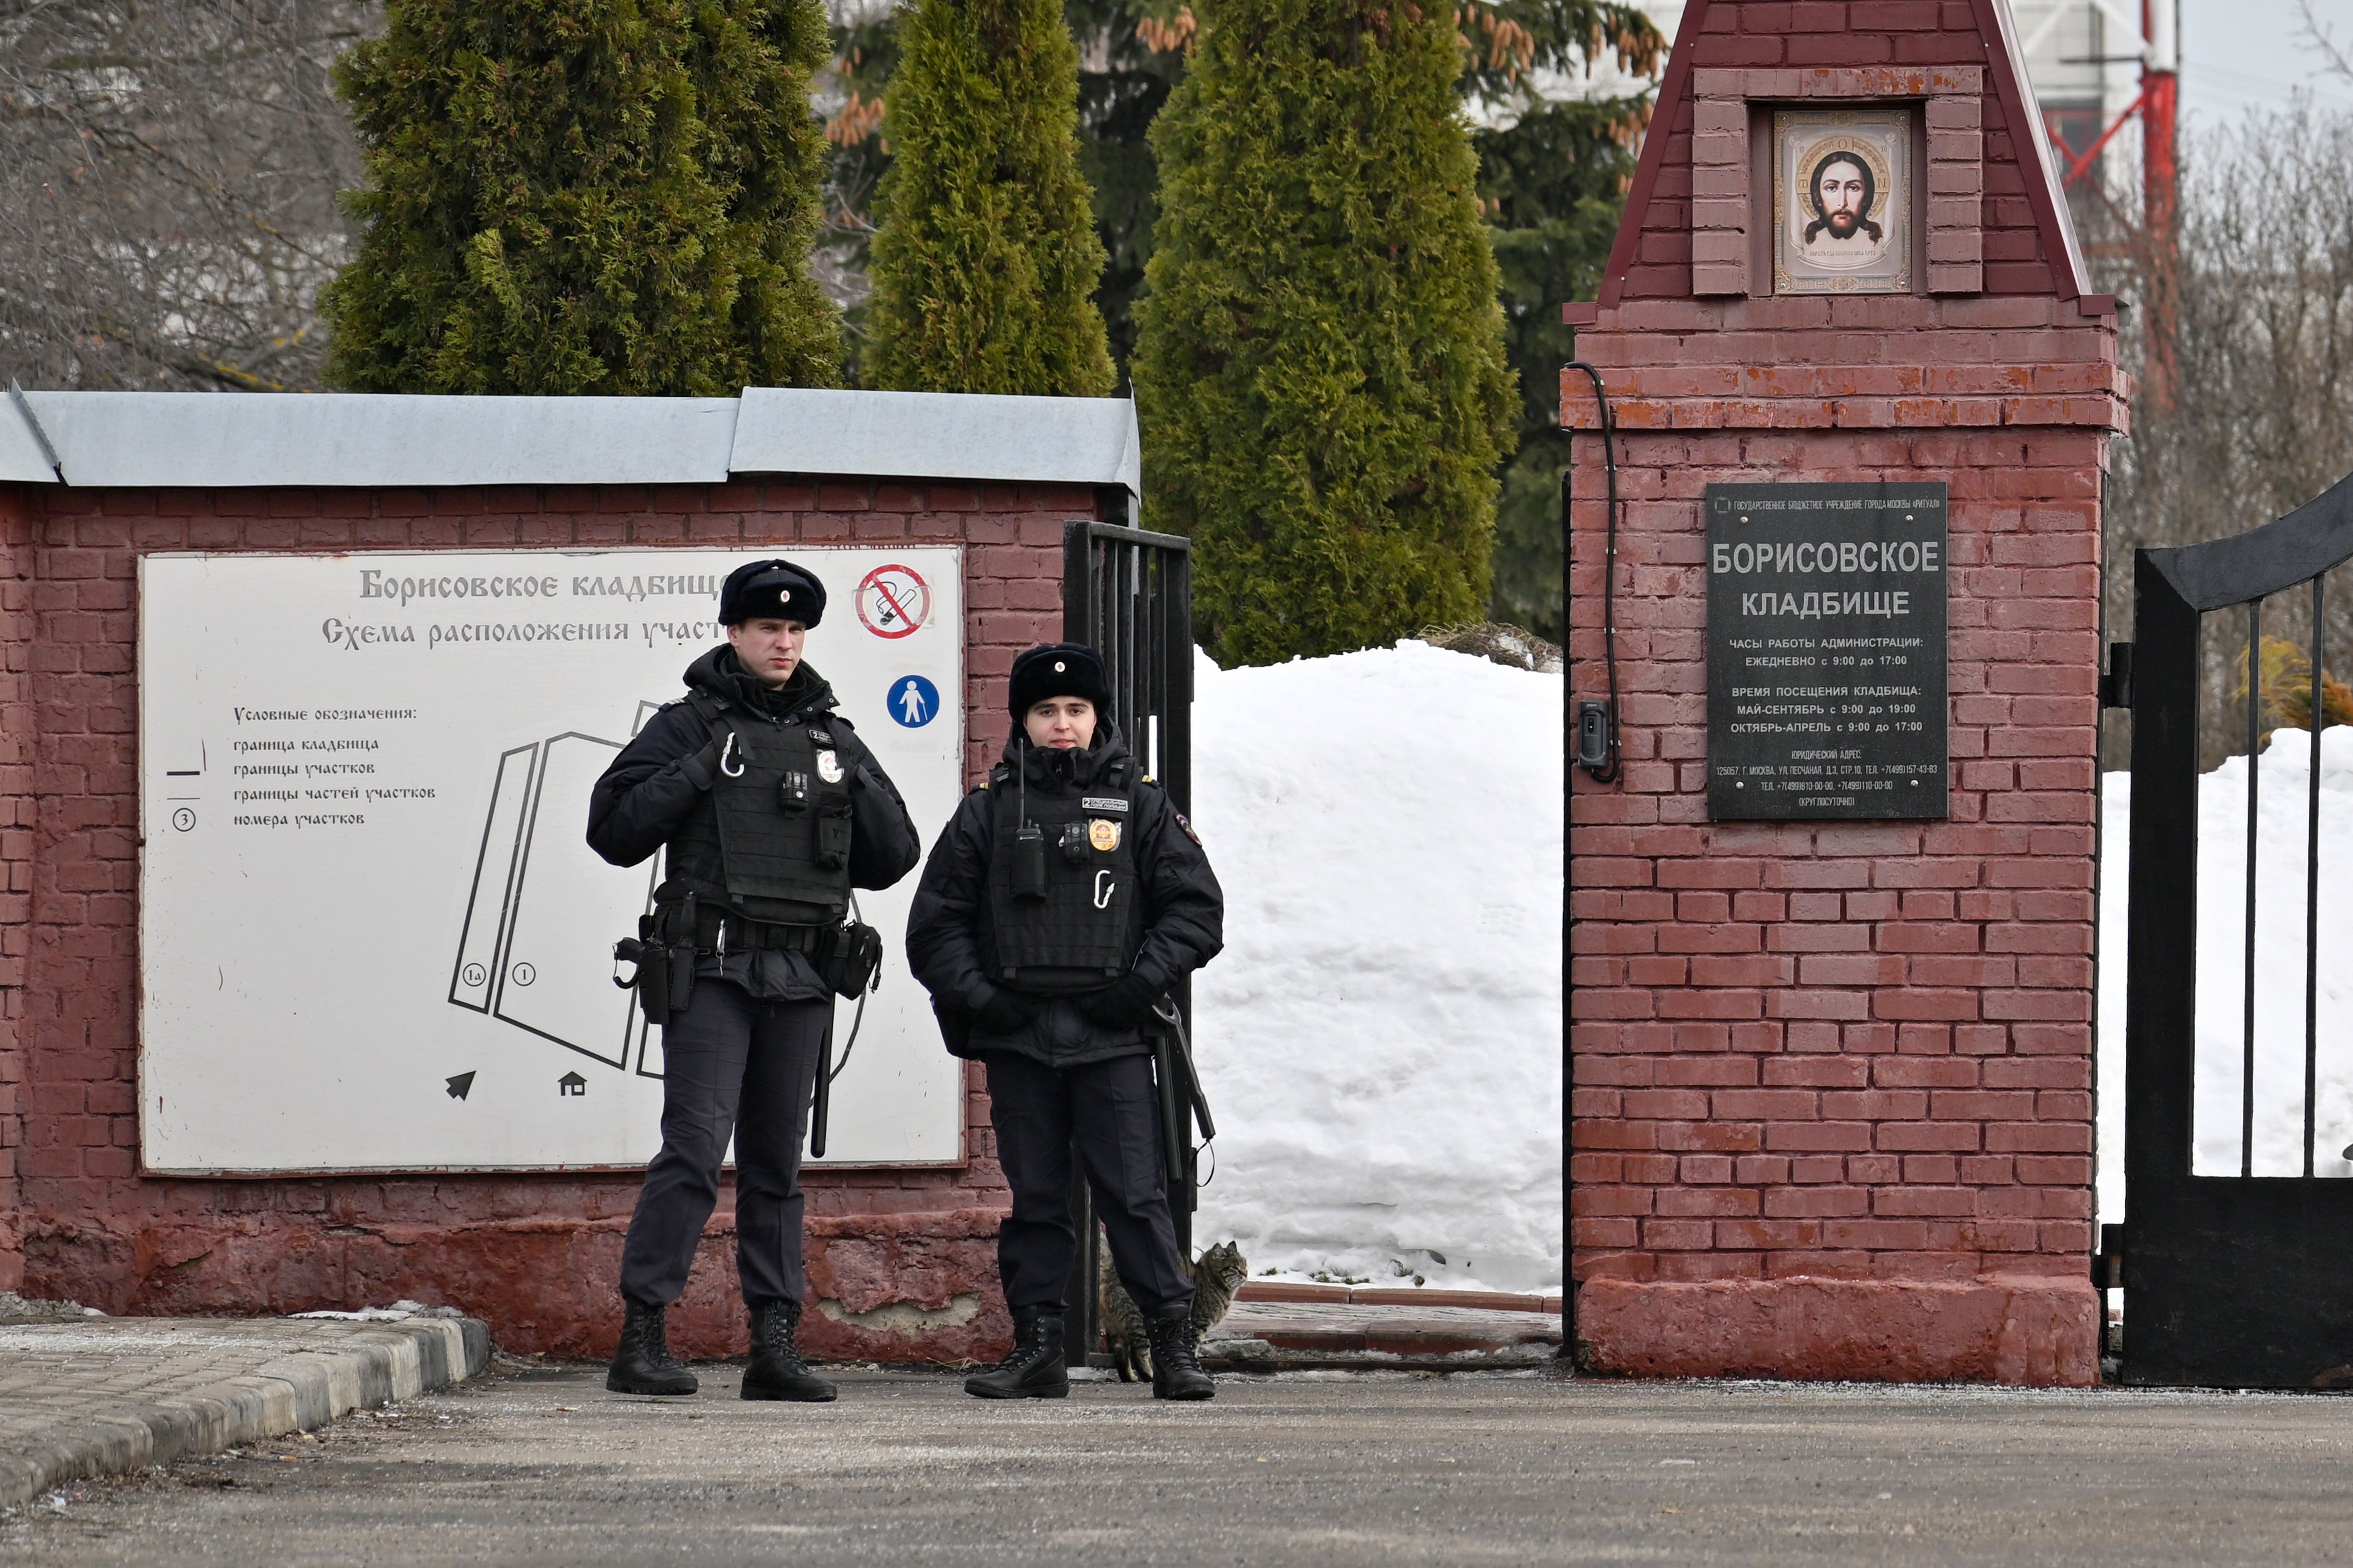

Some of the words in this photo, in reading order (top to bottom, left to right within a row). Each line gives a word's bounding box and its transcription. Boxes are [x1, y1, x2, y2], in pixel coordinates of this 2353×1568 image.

[1735, 501, 1785, 510] ГОСУДАРСТВЕННОЕ
[1788, 501, 1823, 510] БЮДЖЕТНОЕ
[1825, 500, 1862, 510] УЧРЕЖДЕНИЕ
[1865, 500, 1886, 509] ГОРОДА
[1885, 500, 1910, 508] МОСКВЫ
[1913, 500, 1939, 508] «РИТУАЛ»
[1713, 542, 1939, 573] БОРИСОВСКОЕ
[359, 569, 558, 608] Борисовское
[1743, 592, 1909, 619] КЛАДБИЩЕ
[322, 616, 416, 651] Схема
[429, 623, 628, 650] расположения
[642, 619, 727, 649] участ
[1730, 640, 1762, 648] ЧАСЫ
[1769, 639, 1815, 648] РАБОТЫ
[1821, 638, 1923, 649] АДМИНИСТРАЦИИ:
[1746, 657, 1815, 667] ЕЖЕДНЕВНО
[1833, 656, 1854, 665] 9:00
[1860, 658, 1873, 666] до
[1880, 656, 1907, 664] 17:00
[1733, 688, 1770, 696] ВРЕМЯ
[1777, 687, 1847, 697] ПОСЕЩЕНИЯ
[1855, 686, 1921, 697] КЛАДБИЩА:
[1738, 704, 1824, 714] МАЙ-СЕНТЯБРЬ
[1842, 705, 1863, 713] 9:00
[1889, 704, 1915, 713] 19:00
[233, 707, 308, 725] Условные
[314, 709, 416, 720] обозначения:
[1731, 723, 1831, 732] ОКТЯБРЬ-АПРЕЛЬ
[1849, 723, 1869, 731] 9:00
[1876, 724, 1889, 732] до
[1895, 722, 1922, 730] 17:00
[233, 741, 295, 755] граница
[302, 740, 379, 752] кладбища
[1792, 749, 1837, 760] ЮРИДИЧЕСКИЙ
[1840, 750, 1861, 759] АДРЕС:
[233, 765, 298, 779] границы
[305, 764, 375, 779] участков
[1717, 766, 1740, 775] 125057,
[234, 790, 298, 804] границы
[305, 786, 359, 800] частей
[366, 788, 436, 803] участков
[1799, 797, 1855, 806] (КРУГЛОСУТОЧНО)
[181, 814, 188, 826] 3
[234, 815, 288, 829] номера
[295, 814, 365, 829] участков
[522, 969, 526, 980] 1
